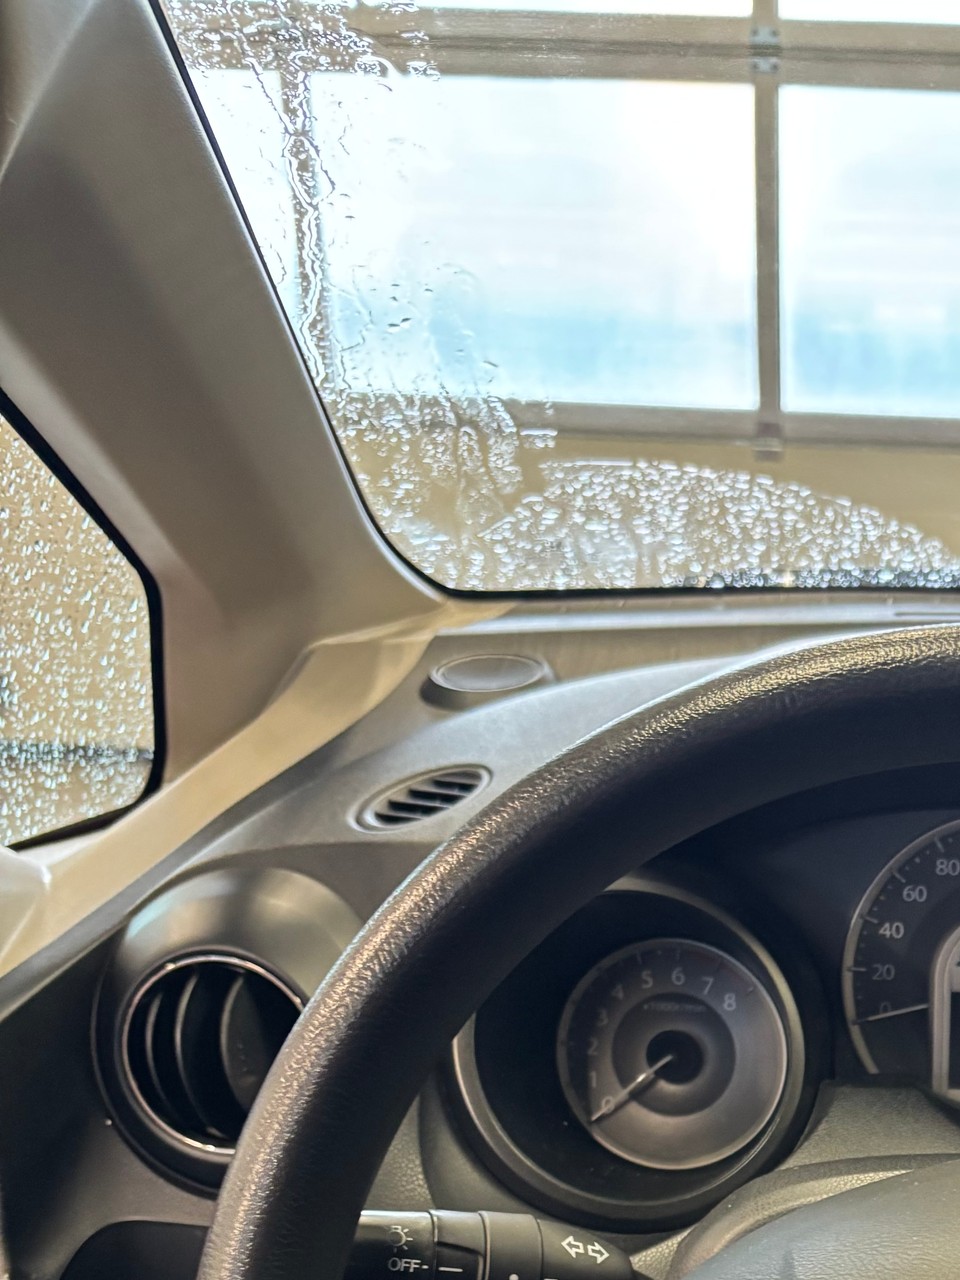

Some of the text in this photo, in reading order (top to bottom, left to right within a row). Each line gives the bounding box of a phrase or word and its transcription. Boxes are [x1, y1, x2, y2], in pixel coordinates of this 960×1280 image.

[935, 859, 960, 877] 80
[902, 886, 927, 903] 60
[879, 922, 904, 940] 40
[641, 970, 653, 989] 5
[671, 966, 685, 986] 6
[872, 963, 895, 981] 20
[611, 983, 624, 1000] 4
[702, 976, 715, 995] 7
[723, 992, 737, 1012] 8
[587, 1037, 599, 1055] 2
[589, 1070, 598, 1089] 1
[601, 1096, 615, 1115] 0
[387, 1256, 421, 1272] OFF
